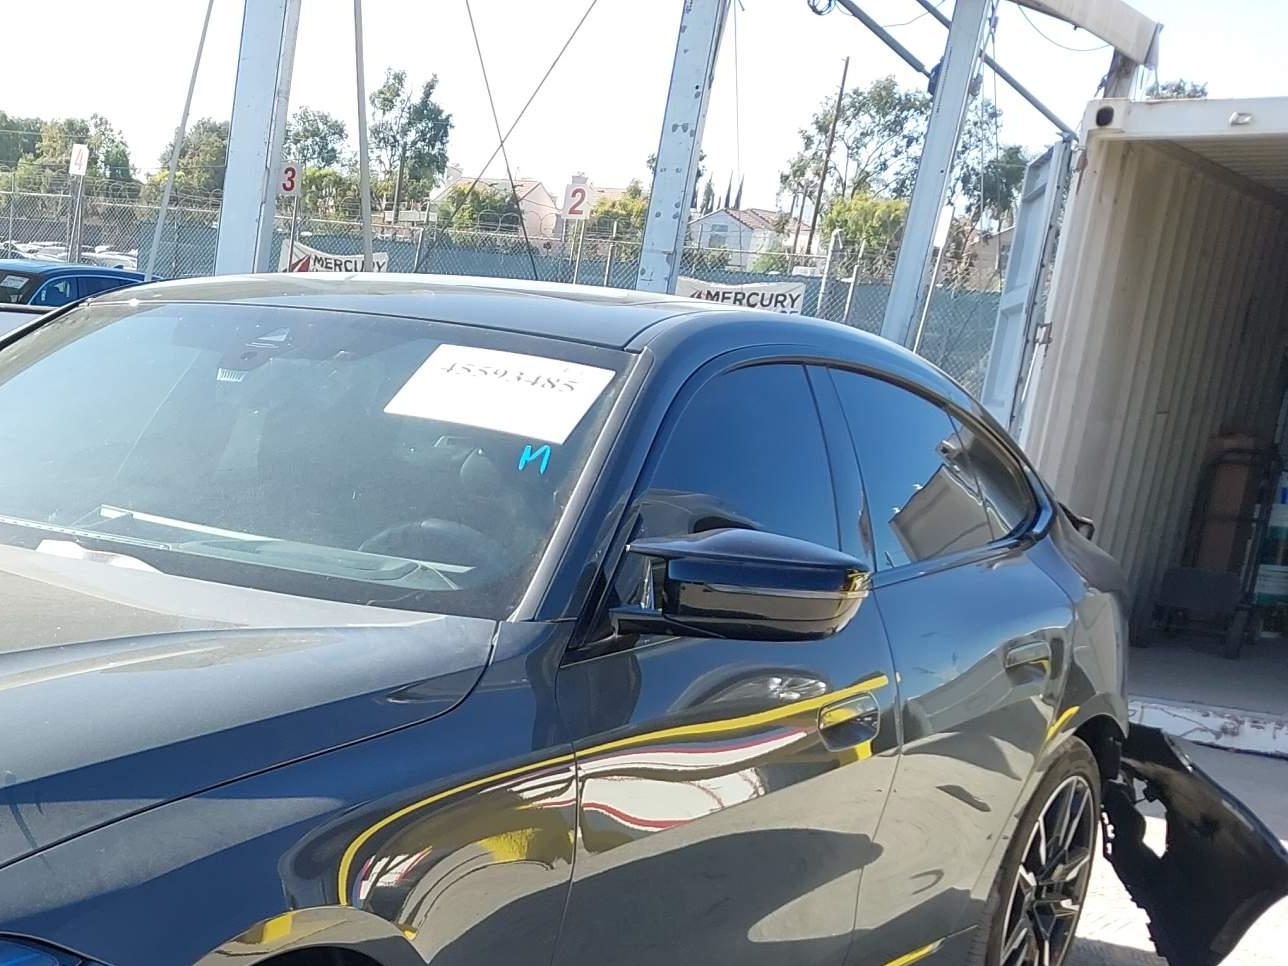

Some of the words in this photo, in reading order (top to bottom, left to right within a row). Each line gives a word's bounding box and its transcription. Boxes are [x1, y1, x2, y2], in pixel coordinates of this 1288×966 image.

[73, 153, 85, 172] 4
[282, 166, 297, 192] 3
[568, 188, 586, 215] 2
[313, 255, 386, 273] MERCUY
